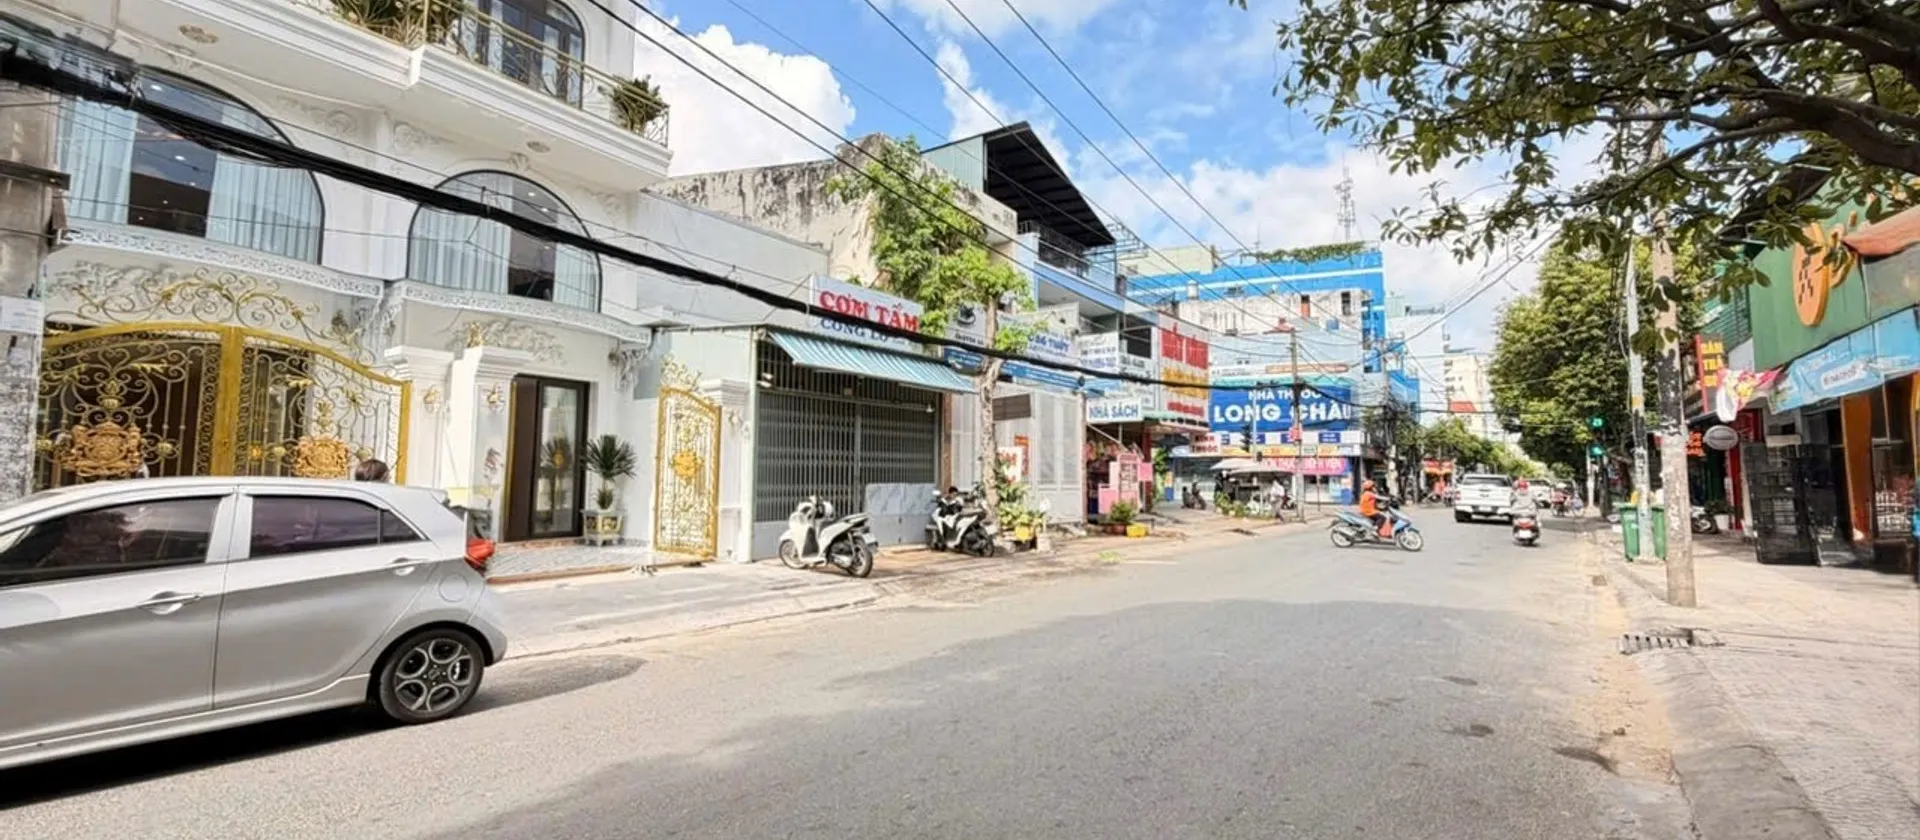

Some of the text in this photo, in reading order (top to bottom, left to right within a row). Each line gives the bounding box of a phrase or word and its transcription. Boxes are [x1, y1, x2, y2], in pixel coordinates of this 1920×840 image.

[819, 290, 920, 332] CƠM TẤM
[1248, 387, 1275, 400] NHÀ
[1089, 401, 1138, 418] NHÀ SÁCH
[1214, 403, 1281, 422] LONG
[1290, 399, 1352, 421] CHÂU
